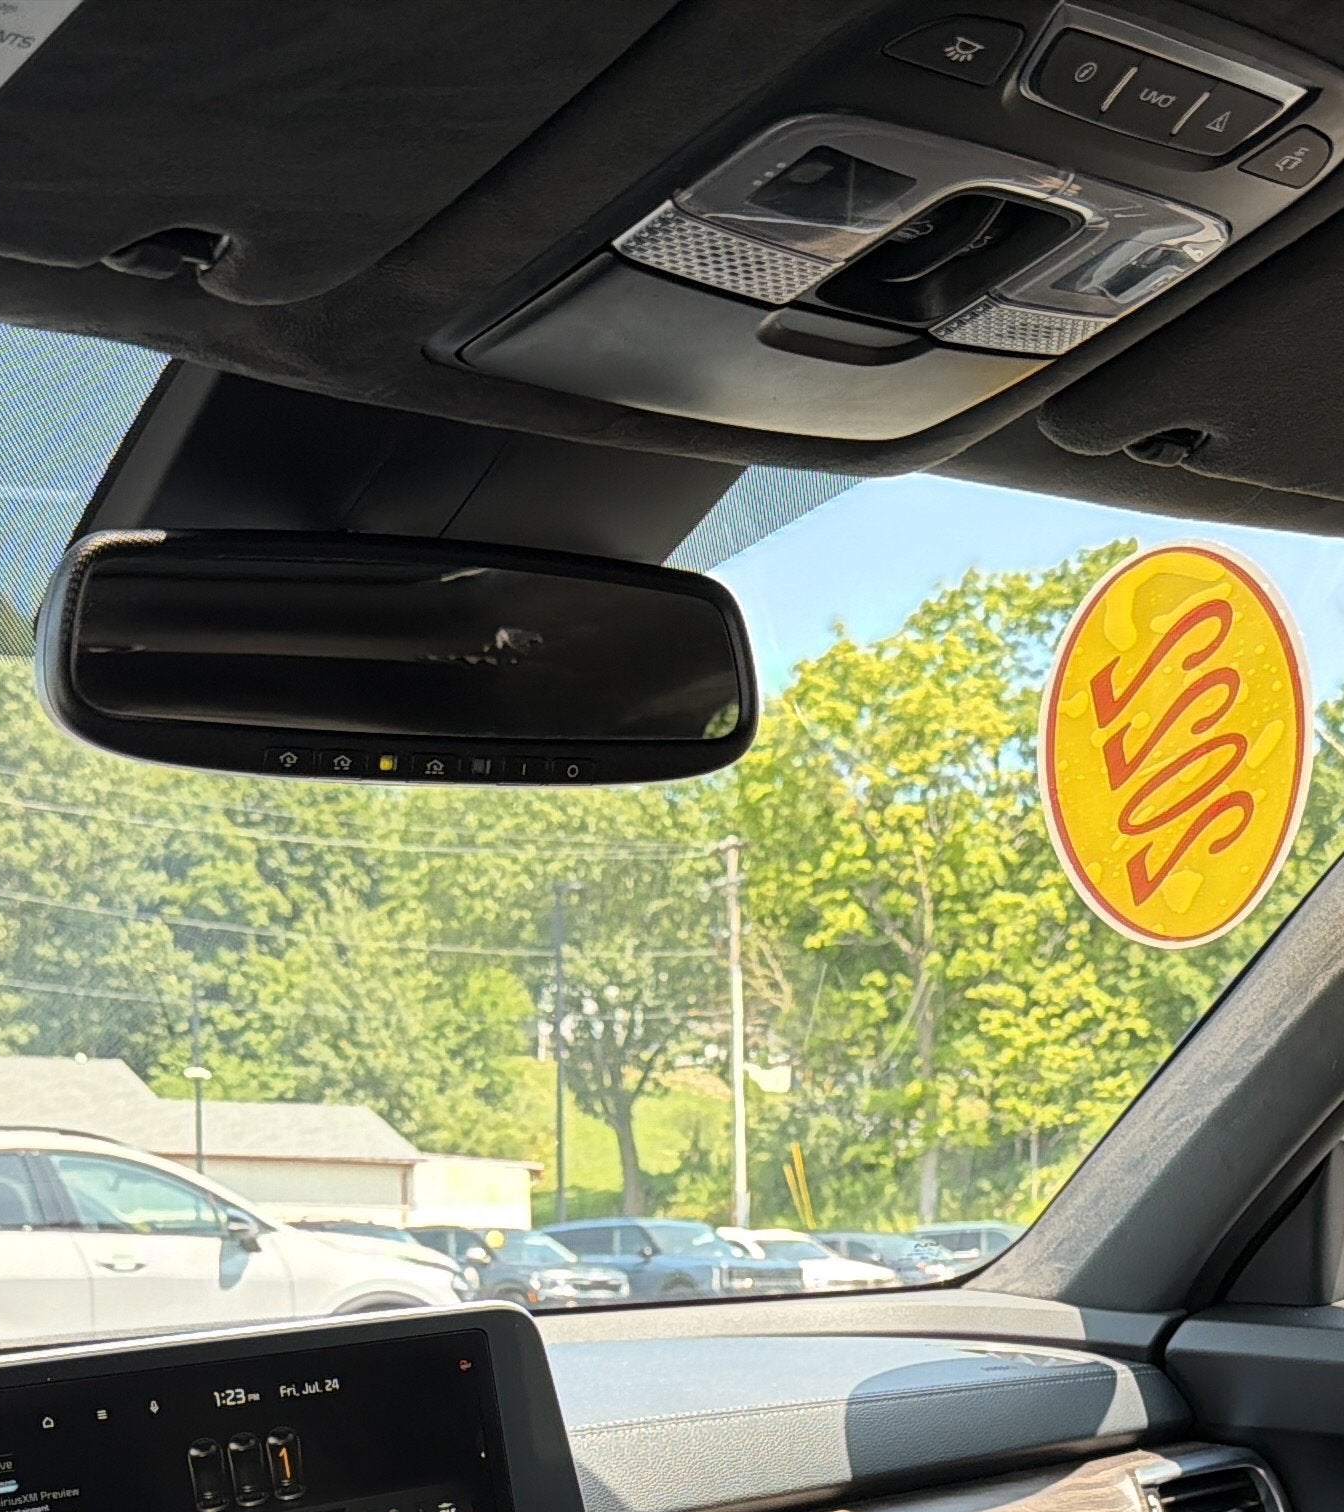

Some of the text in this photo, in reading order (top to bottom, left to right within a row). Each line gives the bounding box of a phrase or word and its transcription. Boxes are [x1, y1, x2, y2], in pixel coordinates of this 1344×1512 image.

[324, 1378, 340, 1392] 24
[213, 1388, 246, 1407] 1:23
[40, 1487, 80, 1501] Preview
